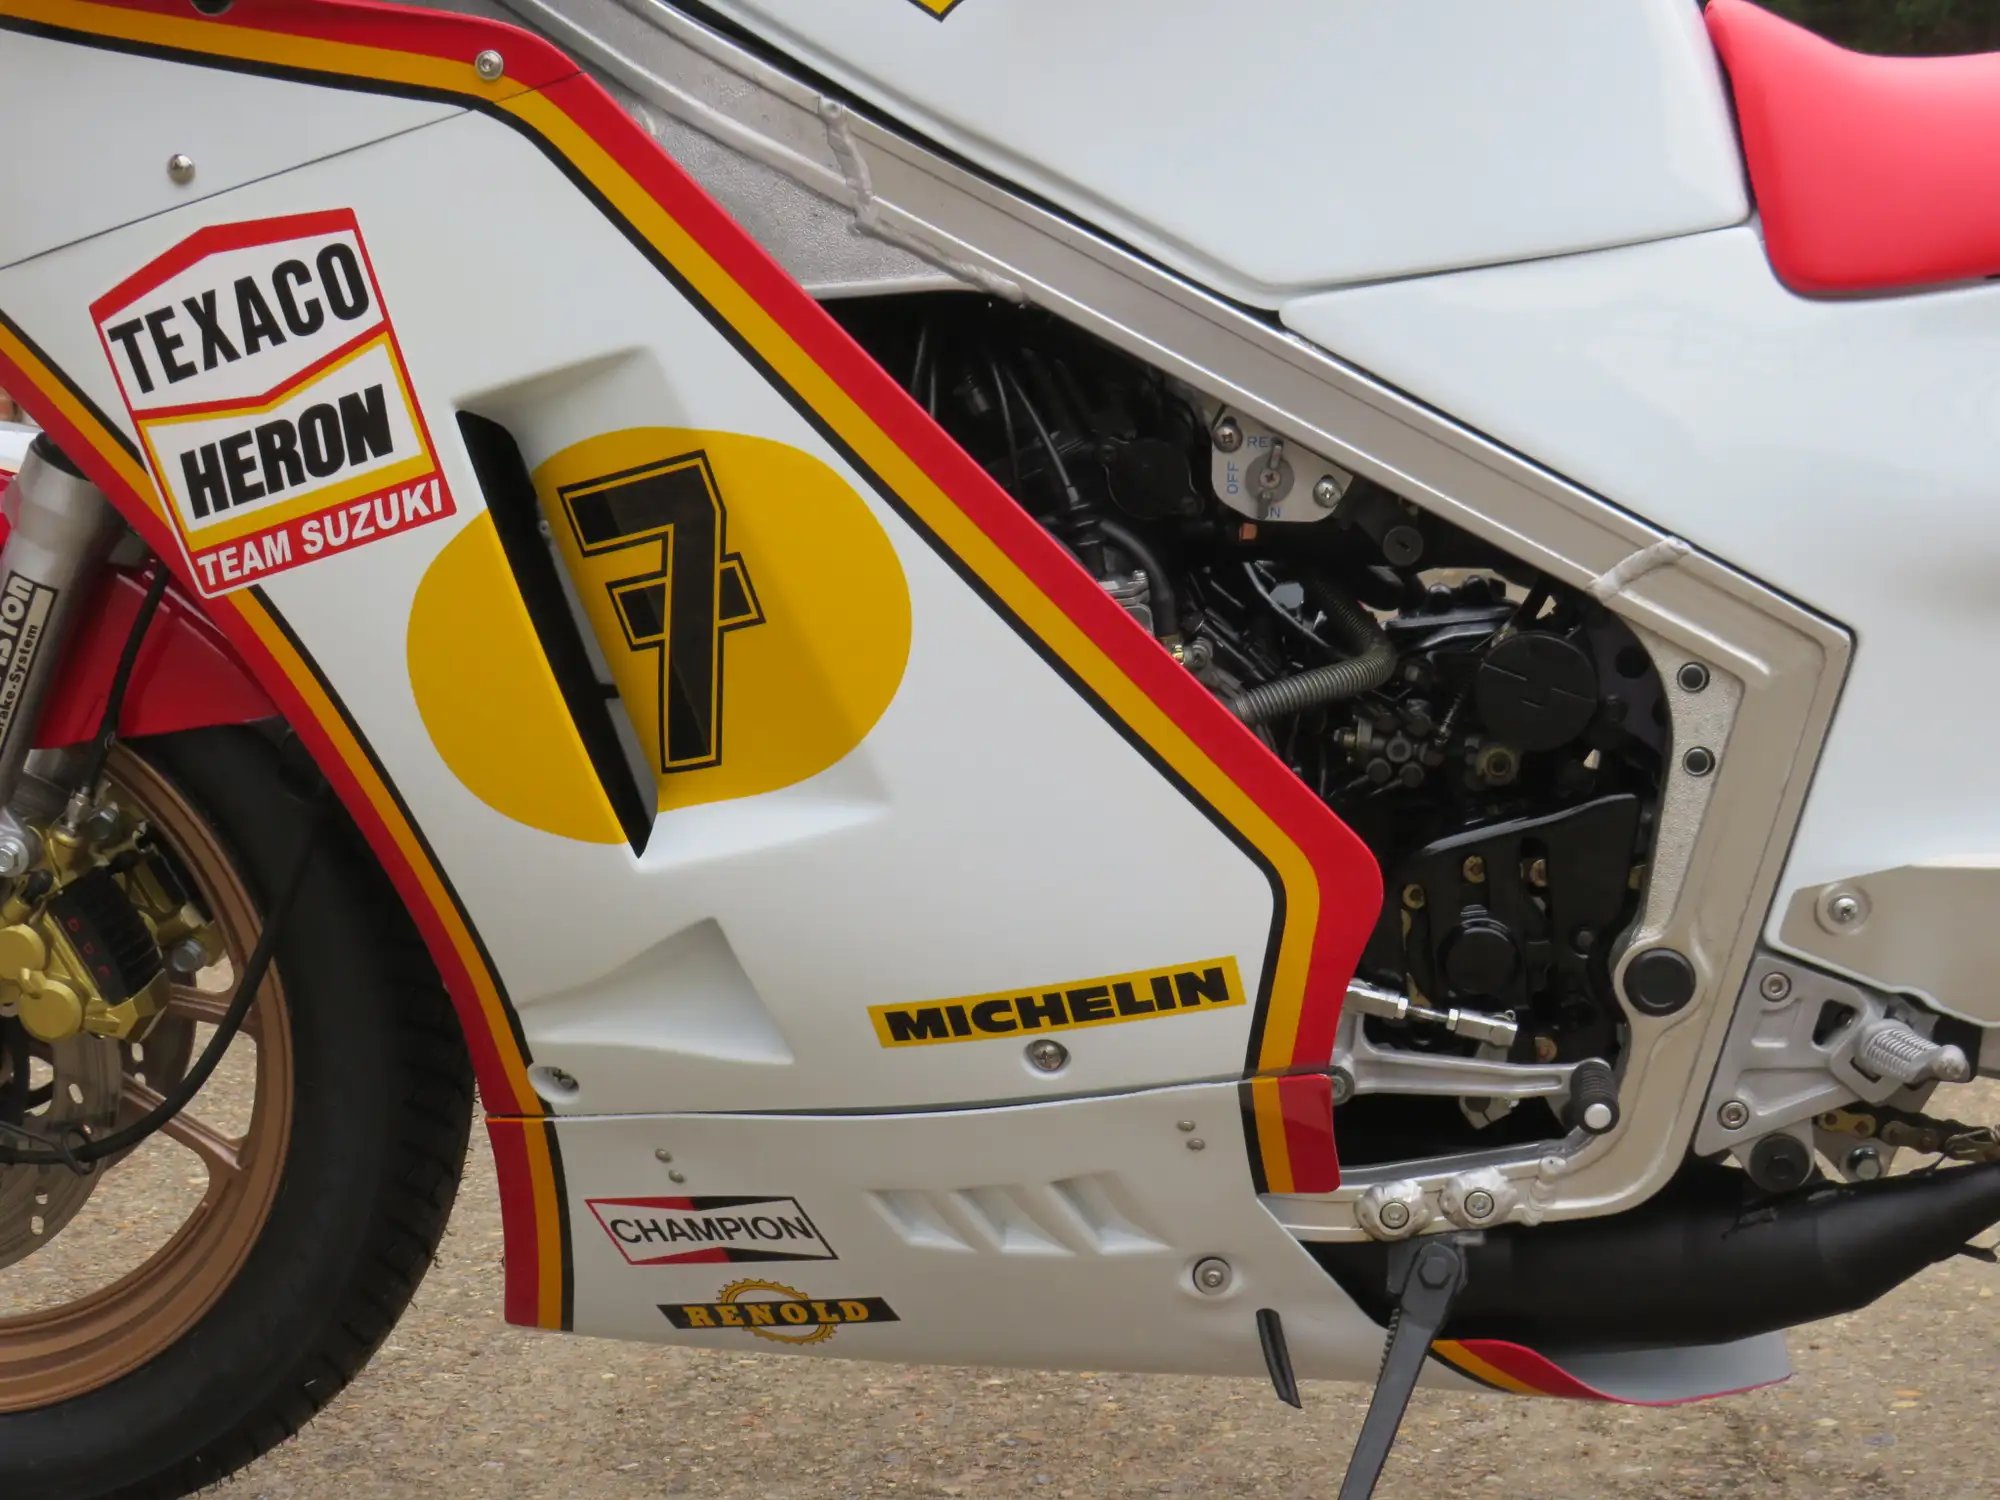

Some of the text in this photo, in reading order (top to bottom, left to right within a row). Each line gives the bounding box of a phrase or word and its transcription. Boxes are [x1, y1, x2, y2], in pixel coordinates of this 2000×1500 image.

[107, 243, 369, 394] TEXACO
[180, 383, 394, 520] HERON
[1227, 461, 1239, 495] OFF
[1247, 436, 1272, 448] RE
[197, 479, 443, 586] TEAM SUZUKI
[557, 449, 767, 775] 7
[884, 966, 1230, 1042] MICHELIN
[610, 1216, 815, 1244] CHAMPION
[682, 1301, 870, 1327] RENOLD
